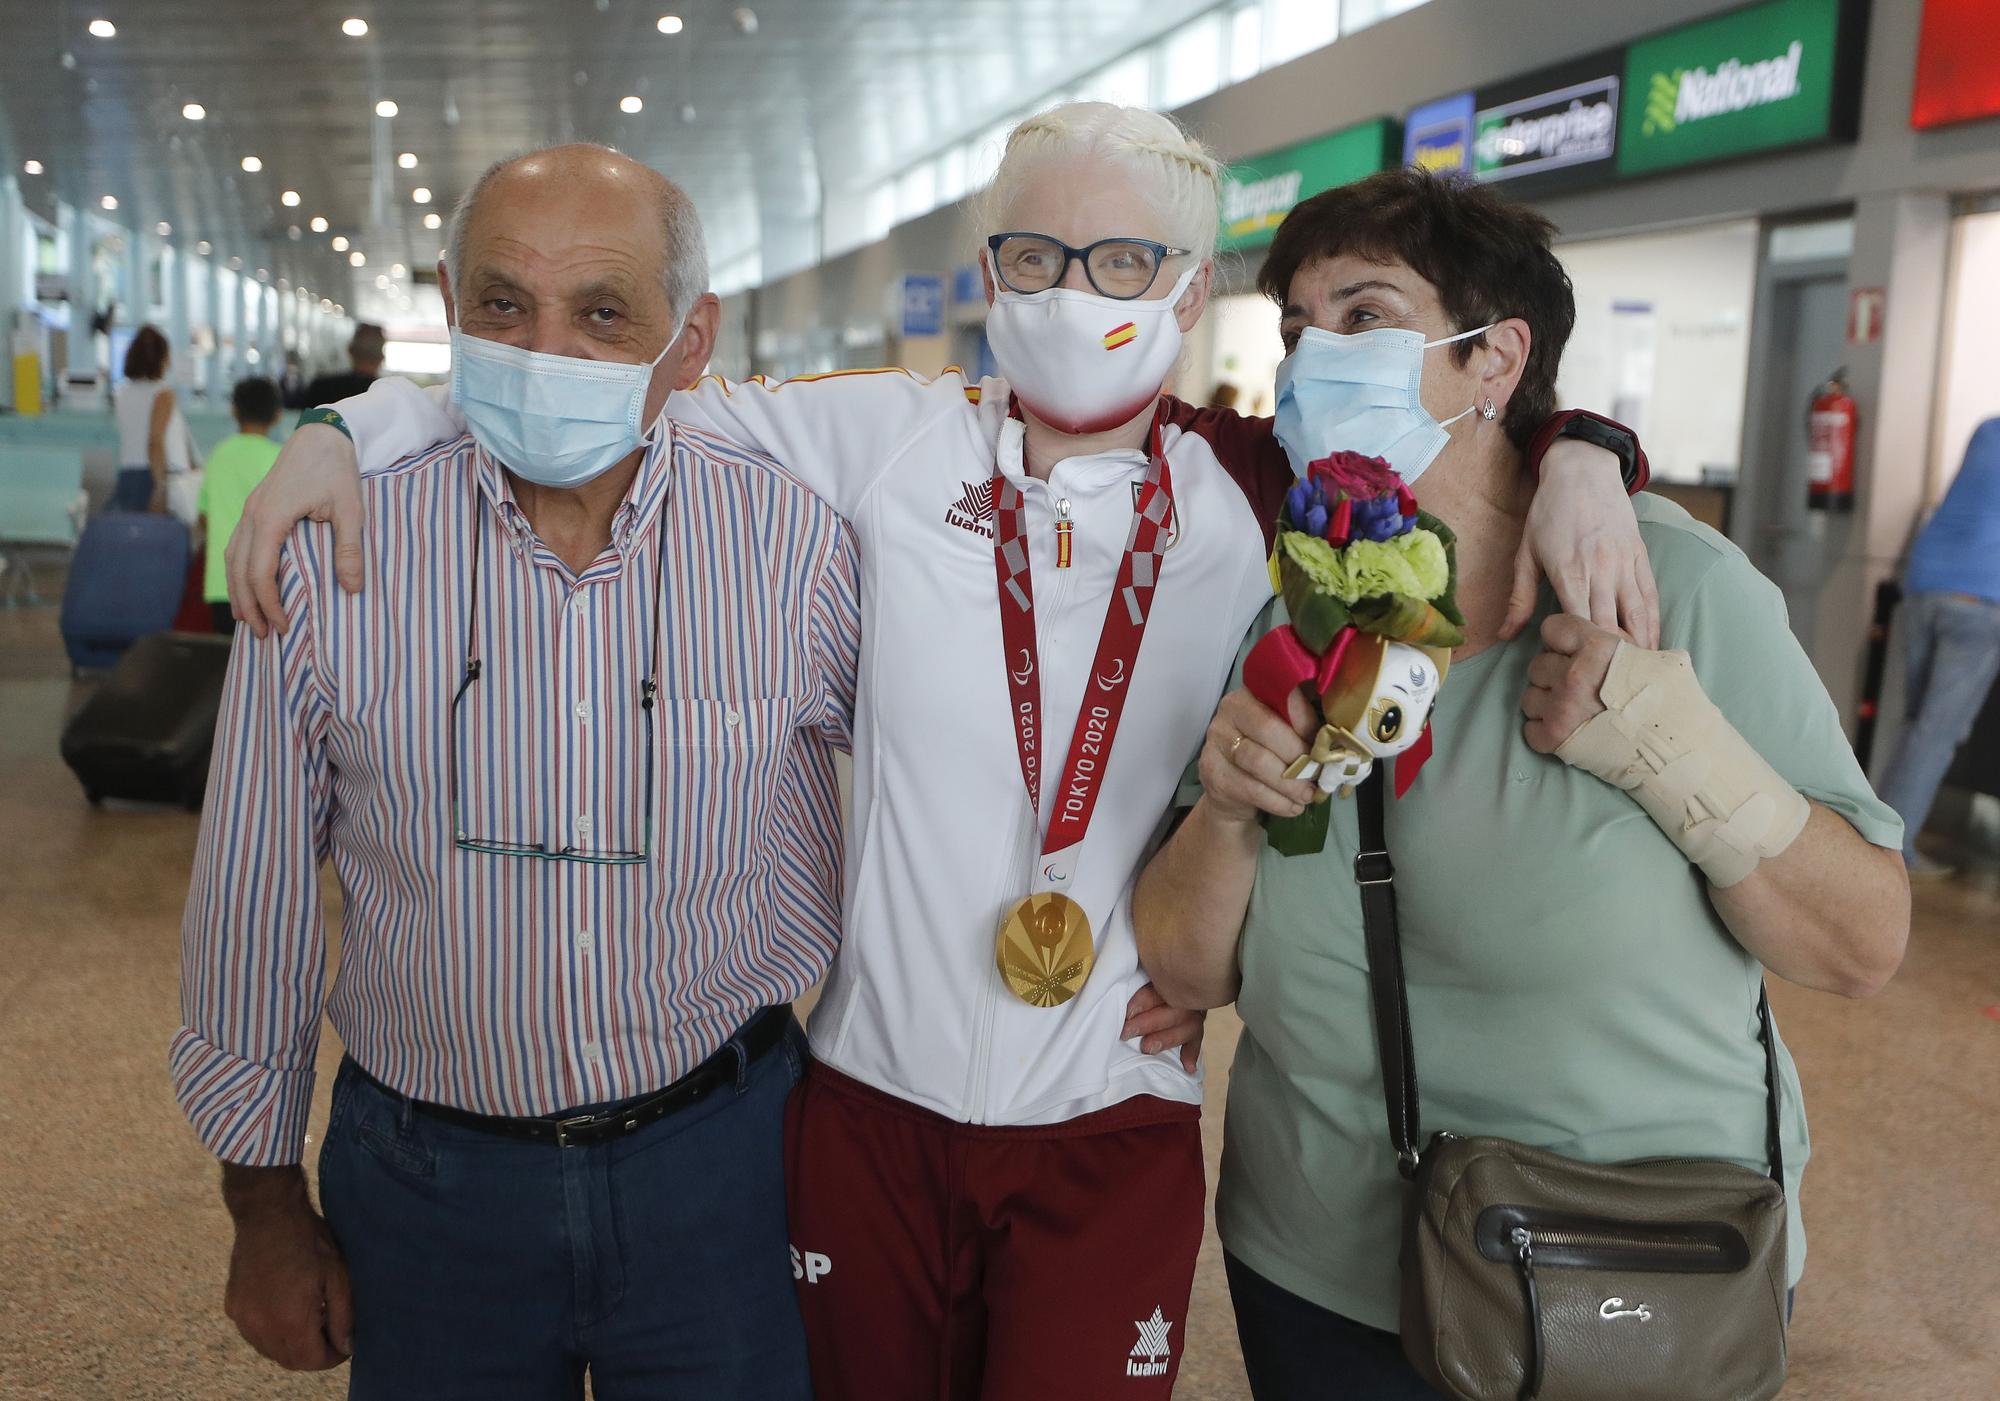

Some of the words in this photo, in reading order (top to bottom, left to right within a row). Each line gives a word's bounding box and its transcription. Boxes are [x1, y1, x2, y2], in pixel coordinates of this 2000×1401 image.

[1674, 40, 1803, 124] National
[1019, 701, 1035, 752] 2020
[1026, 756, 1039, 816] OKYO
[1061, 758, 1095, 823] TOKYO
[1081, 706, 1110, 756] 2020
[1126, 1357, 1169, 1377] luanvi
